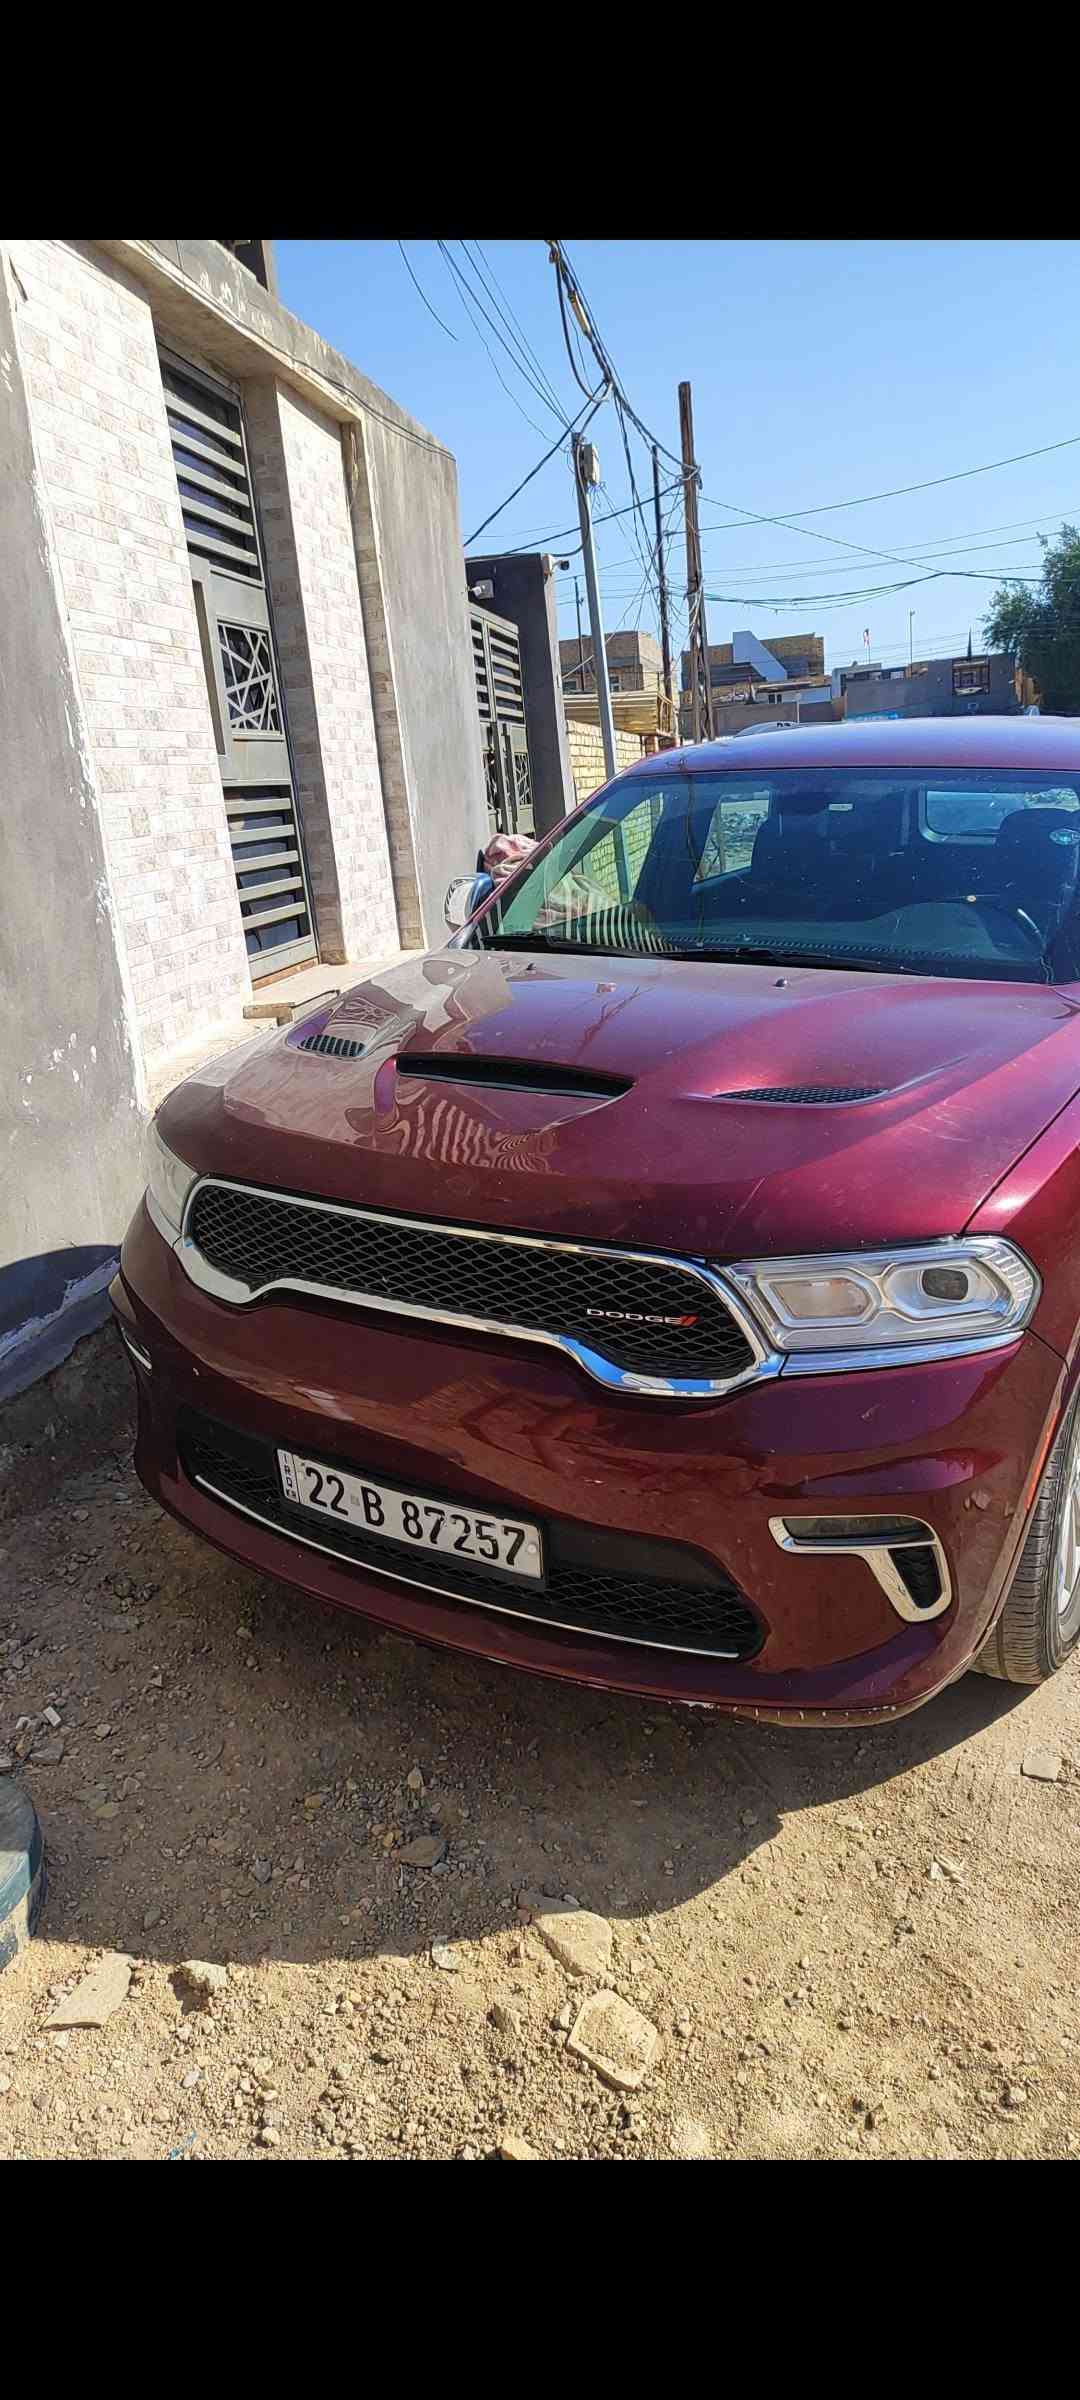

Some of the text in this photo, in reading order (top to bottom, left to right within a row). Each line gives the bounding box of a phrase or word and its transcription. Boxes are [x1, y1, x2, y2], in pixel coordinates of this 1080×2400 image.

[586, 1308, 682, 1325] DODGE
[305, 1466, 526, 1566] 22 B 87257
